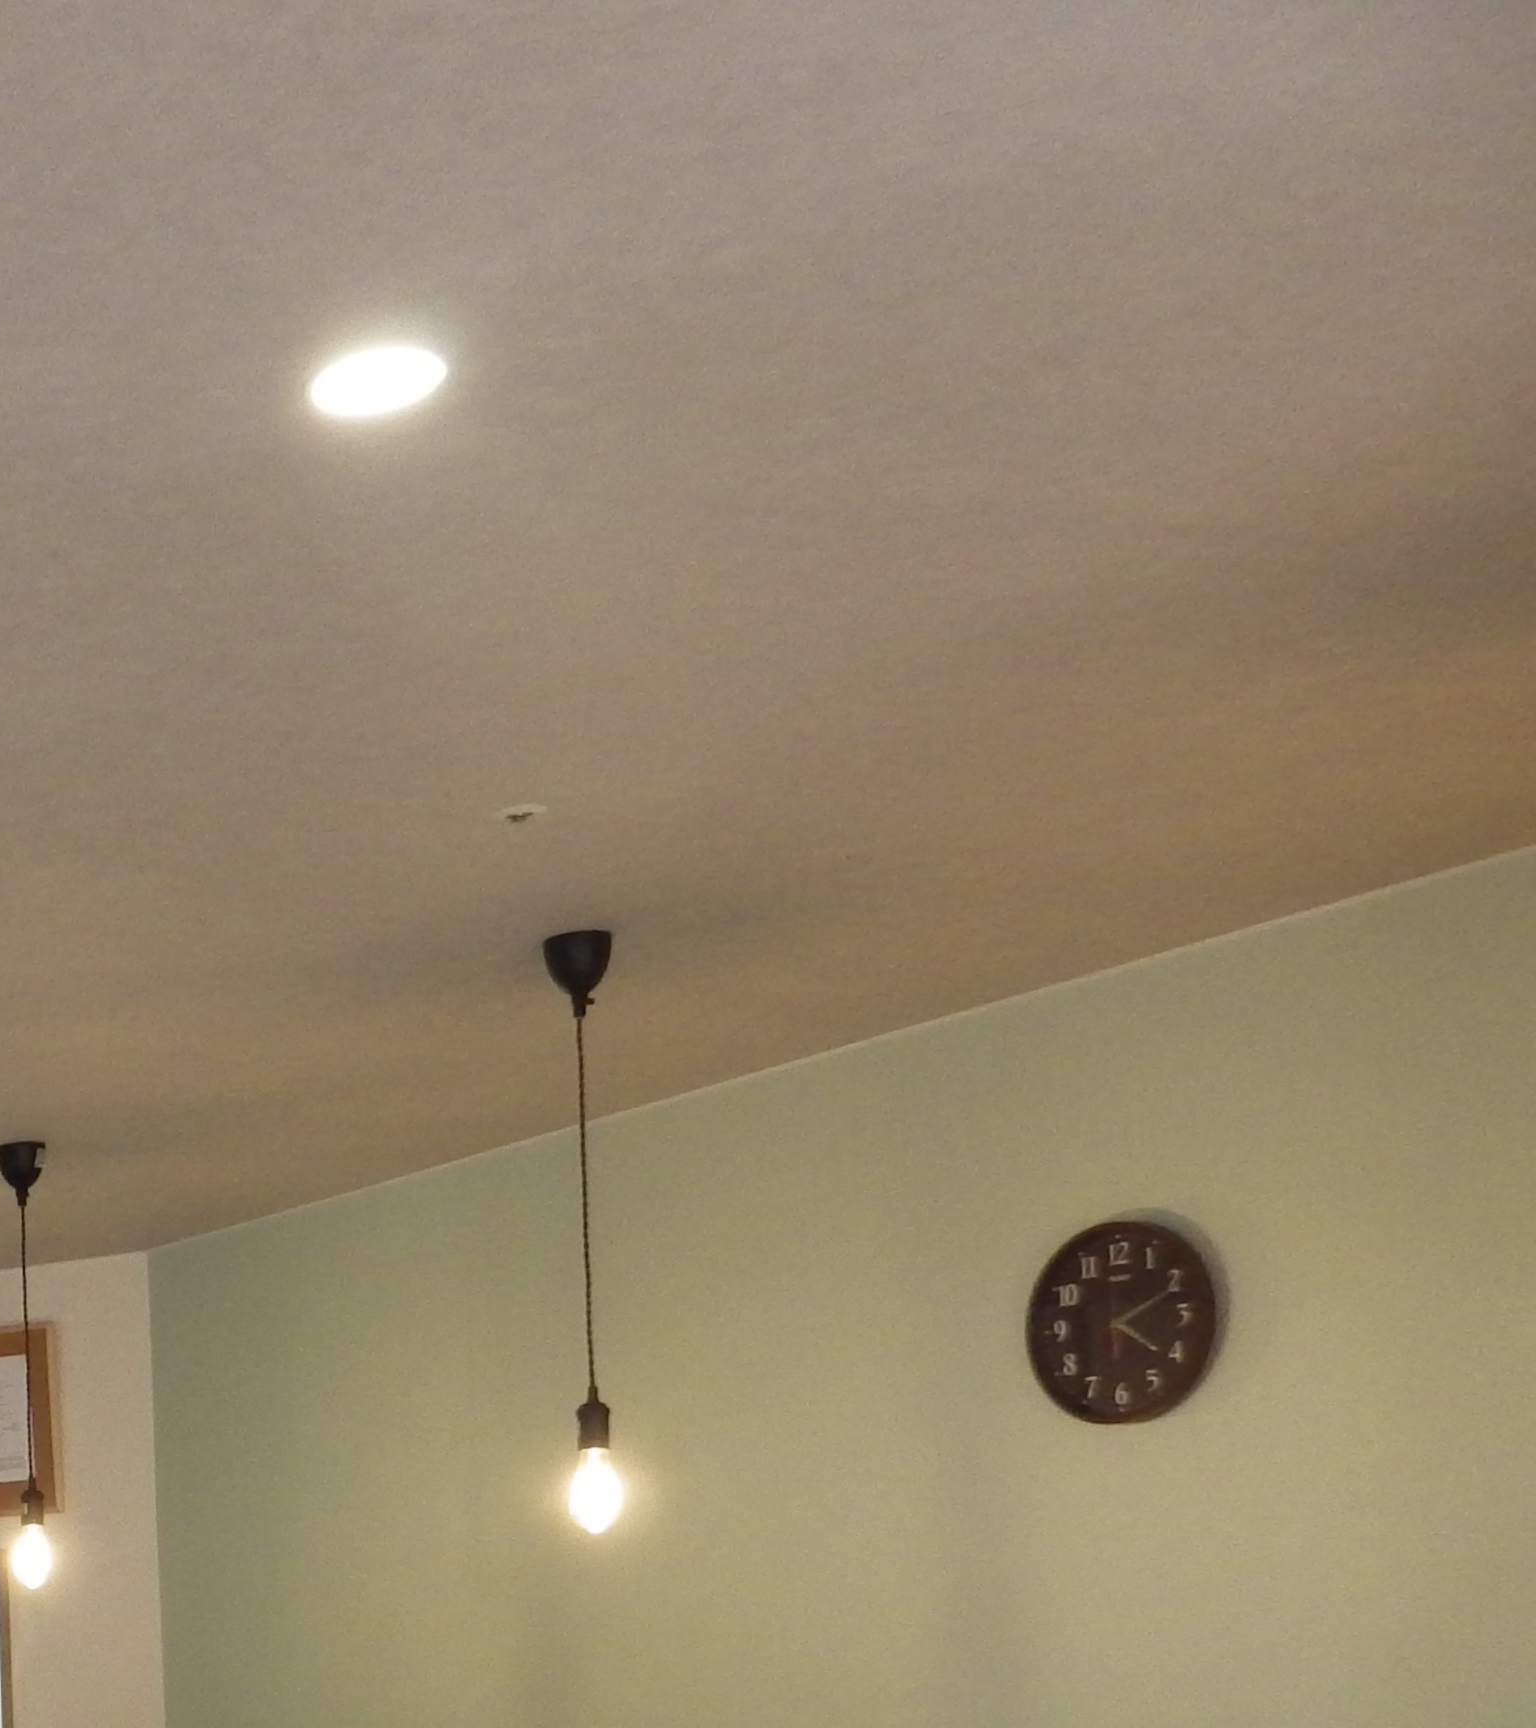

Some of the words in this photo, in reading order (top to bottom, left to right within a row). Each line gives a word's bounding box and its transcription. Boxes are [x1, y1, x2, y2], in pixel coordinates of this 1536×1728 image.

[1108, 1241, 1129, 1266] 12
[1145, 1246, 1156, 1270] 1
[1080, 1256, 1097, 1279] 11
[1167, 1269, 1183, 1292] 2
[1057, 1283, 1078, 1308] 10
[1177, 1303, 1193, 1327] 3
[1053, 1320, 1068, 1342] 9
[1168, 1340, 1184, 1363] 4
[1062, 1353, 1077, 1376] 8
[1085, 1375, 1101, 1398] 7
[1145, 1369, 1161, 1392] 5
[1114, 1382, 1129, 1405] 6
